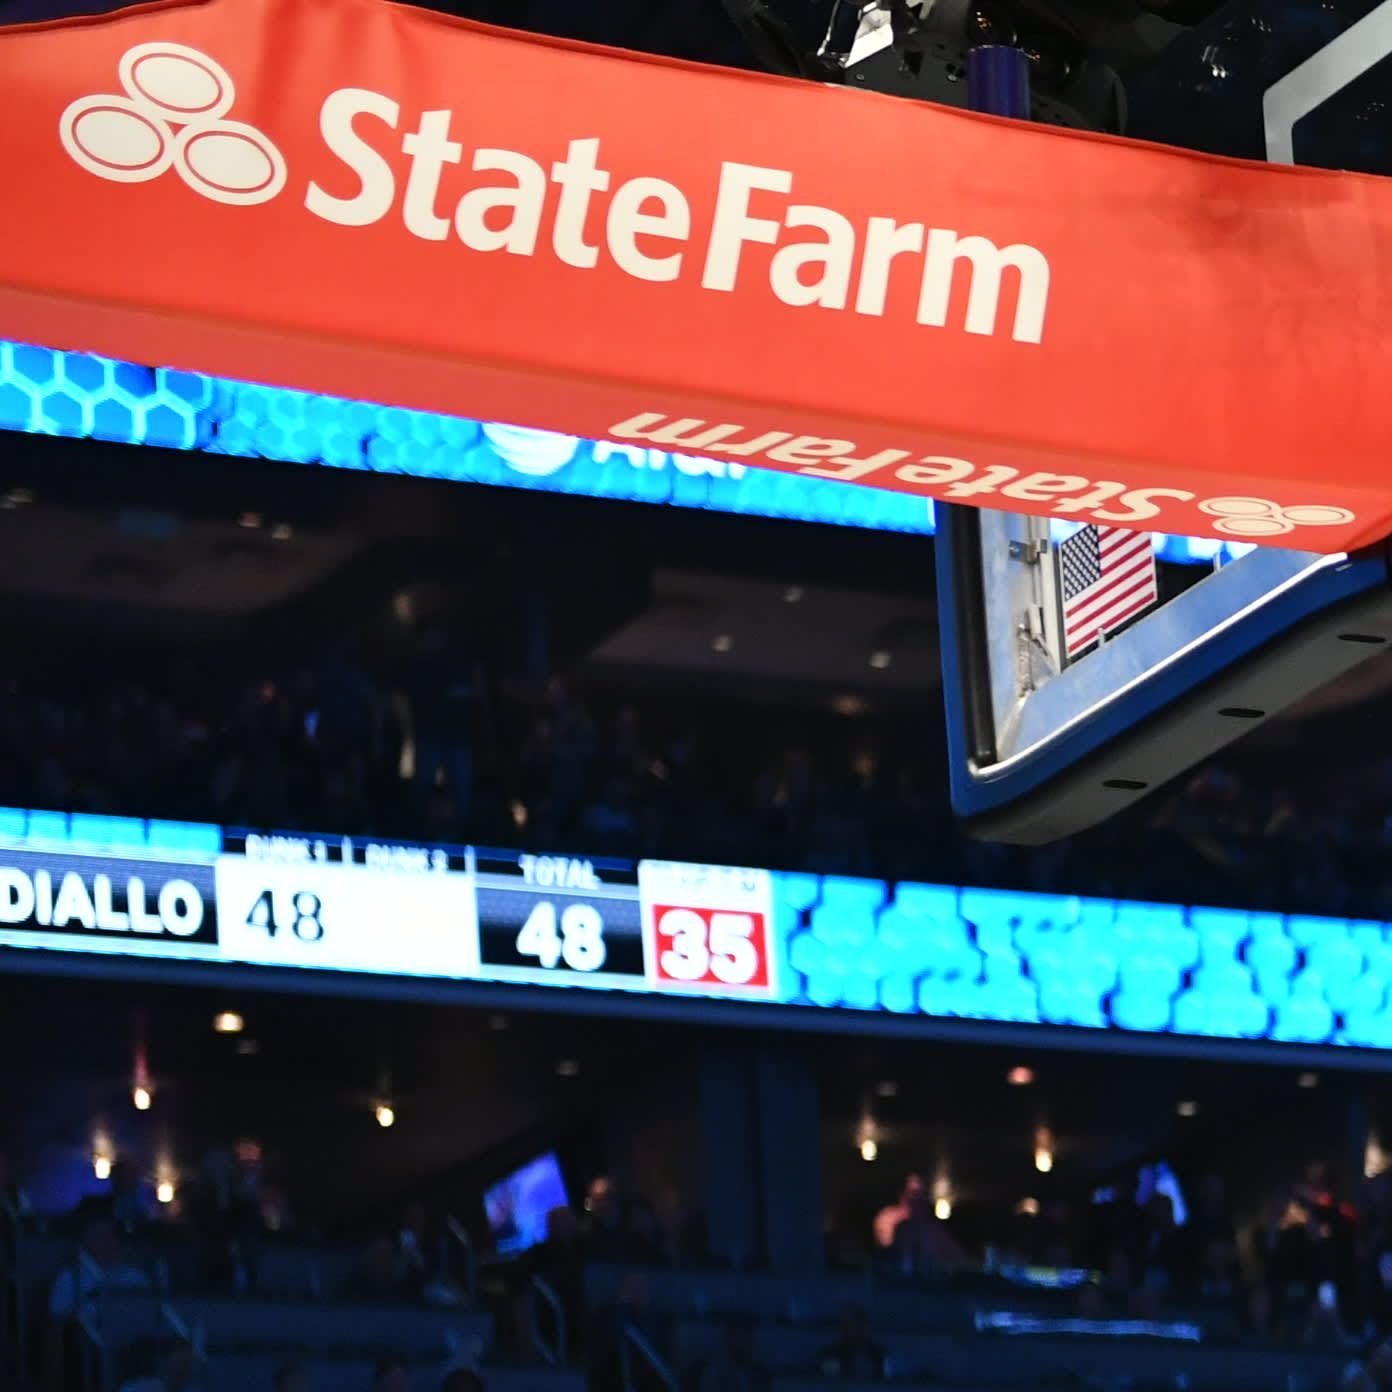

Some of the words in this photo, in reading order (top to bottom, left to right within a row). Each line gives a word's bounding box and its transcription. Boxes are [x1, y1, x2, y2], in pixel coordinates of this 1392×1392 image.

[0, 866, 204, 936] DIALLO
[518, 853, 600, 889] TOTAL
[247, 889, 324, 941] 48
[516, 901, 606, 972] 48
[658, 909, 759, 984] 35
